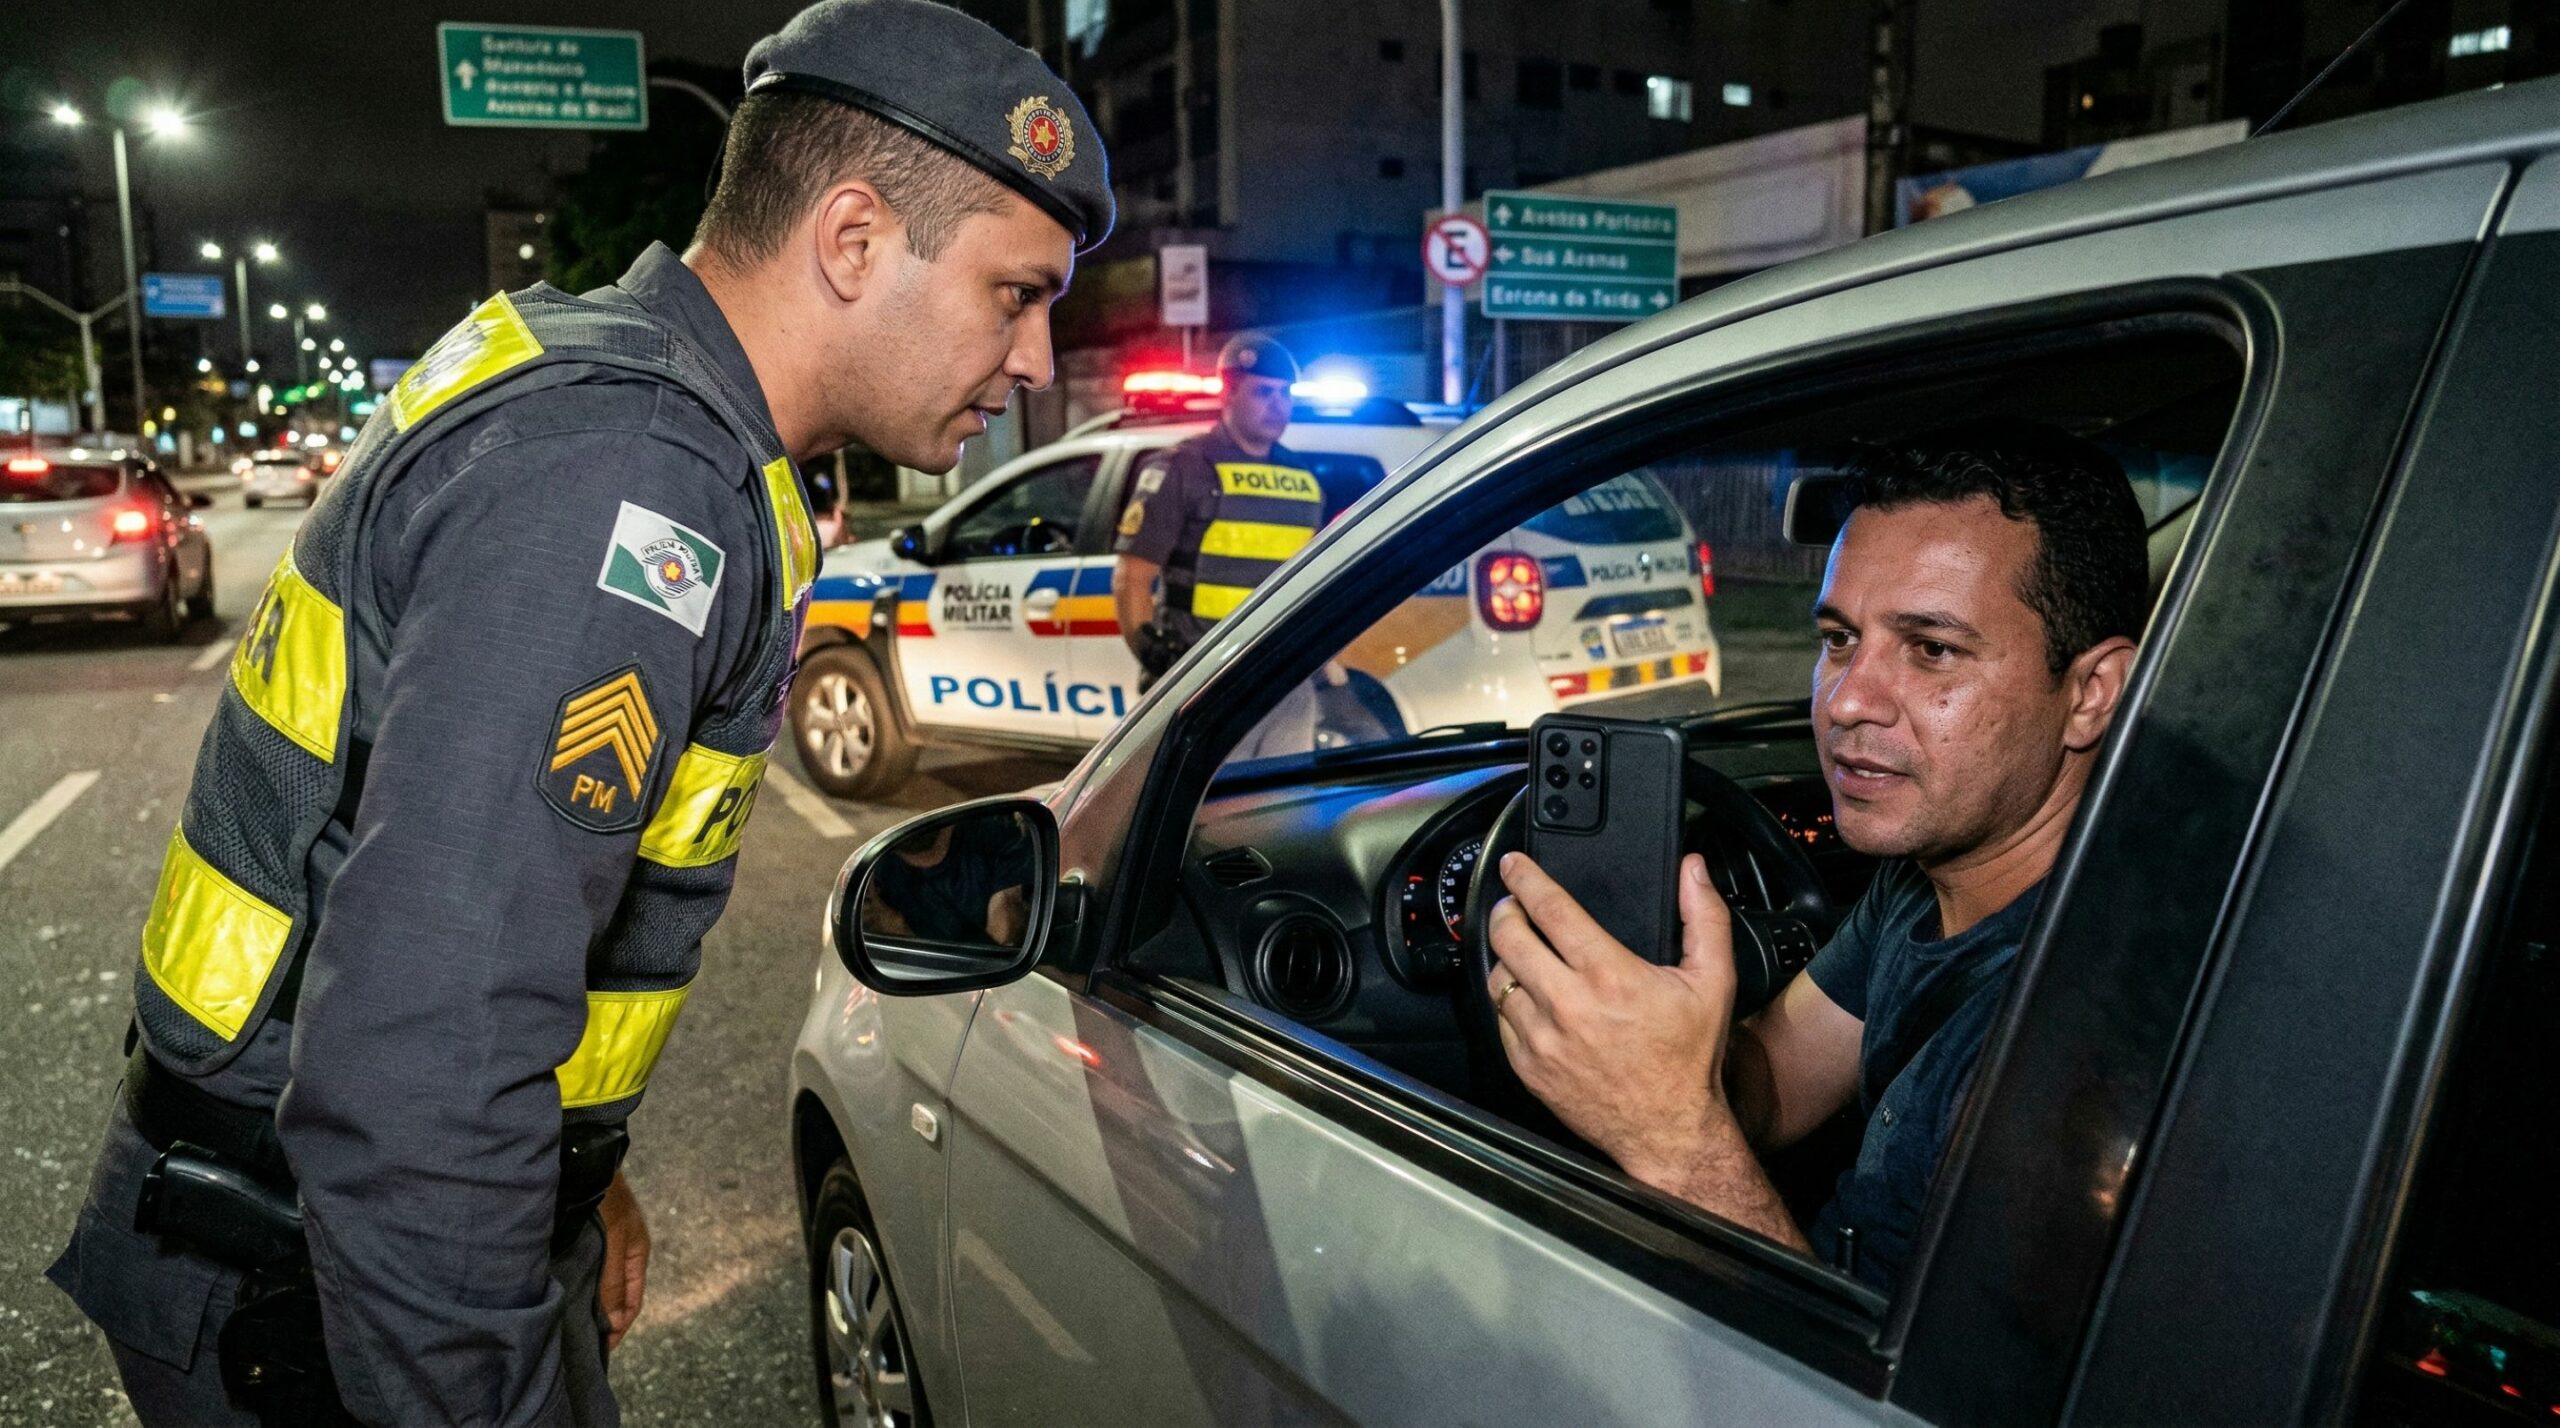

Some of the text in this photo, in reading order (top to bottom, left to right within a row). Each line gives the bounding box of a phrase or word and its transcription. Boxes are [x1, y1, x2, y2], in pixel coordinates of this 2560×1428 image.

[1232, 471, 1312, 493] POLÍCIA
[943, 578, 1012, 601] POLÍCIA
[943, 605, 1012, 623] MILITAR
[930, 671, 1127, 718] POLÍCI
[570, 774, 618, 814] PM
